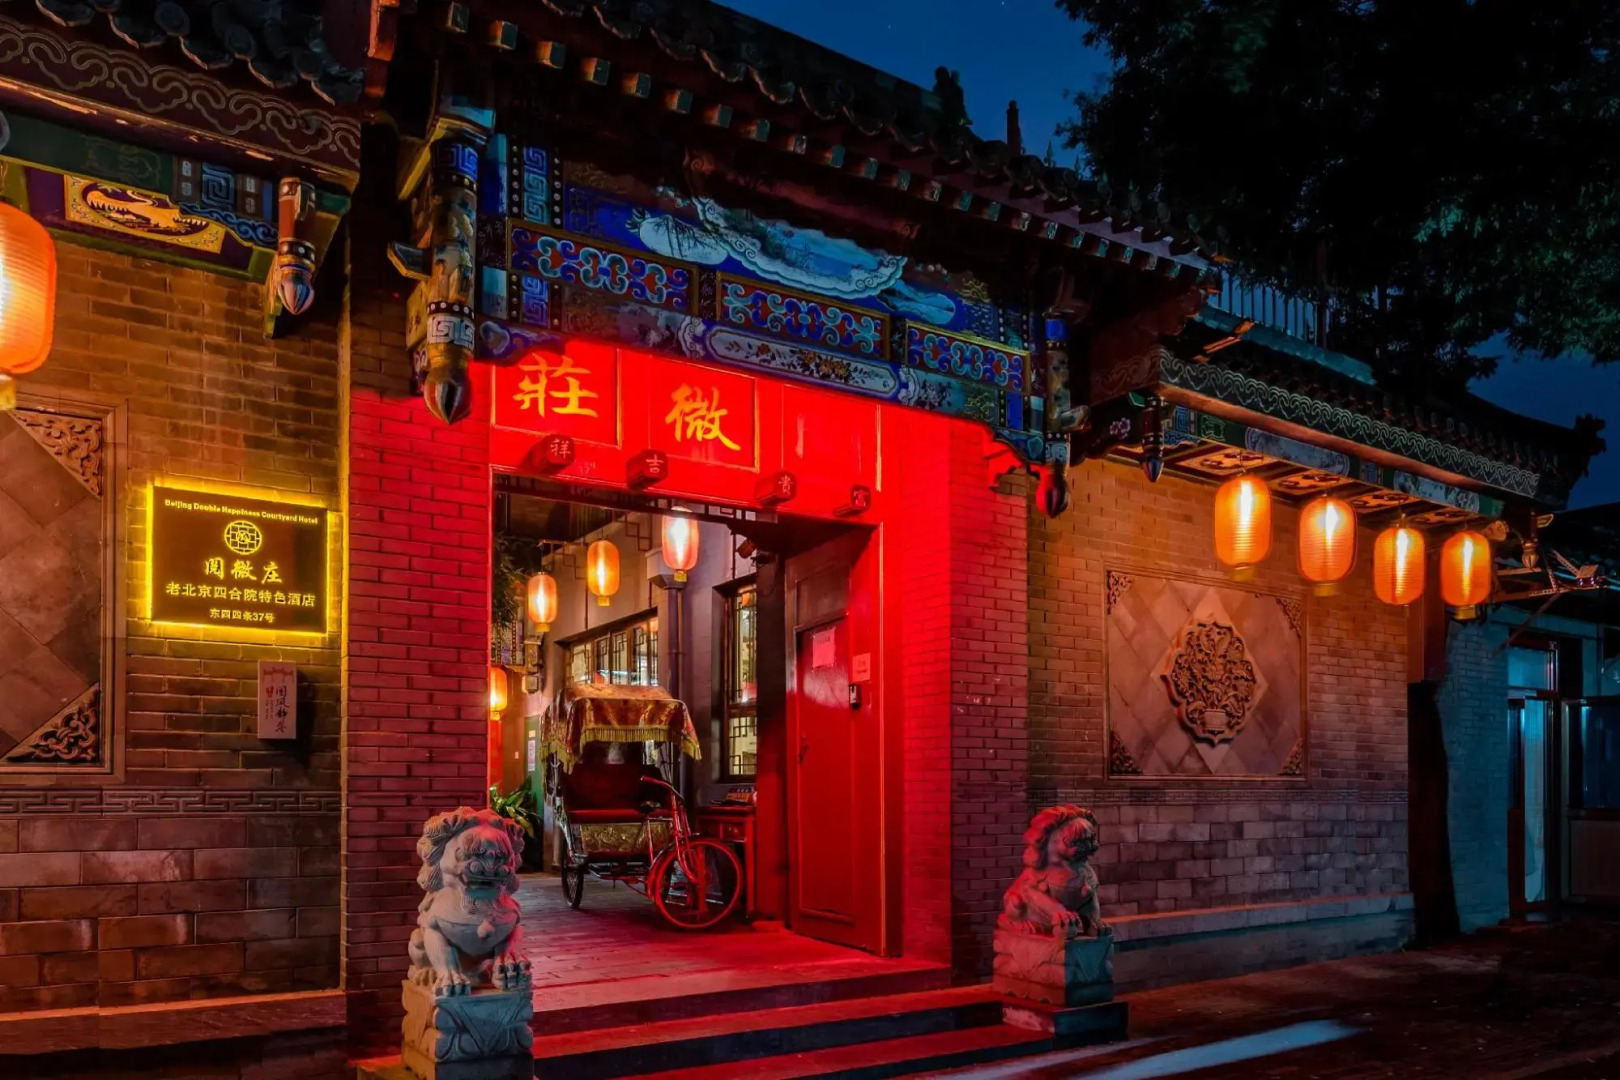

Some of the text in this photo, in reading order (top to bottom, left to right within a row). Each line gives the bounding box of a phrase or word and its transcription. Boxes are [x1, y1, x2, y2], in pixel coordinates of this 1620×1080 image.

[512, 353, 742, 451] 微 莊
[550, 438, 571, 459] 祥
[644, 454, 664, 474] 吉
[164, 498, 318, 525] Beijing Double Happiness Courtyard Hotel
[166, 582, 315, 607] 老北京四合院特色酒店
[210, 608, 274, 623] 东四四条37号
